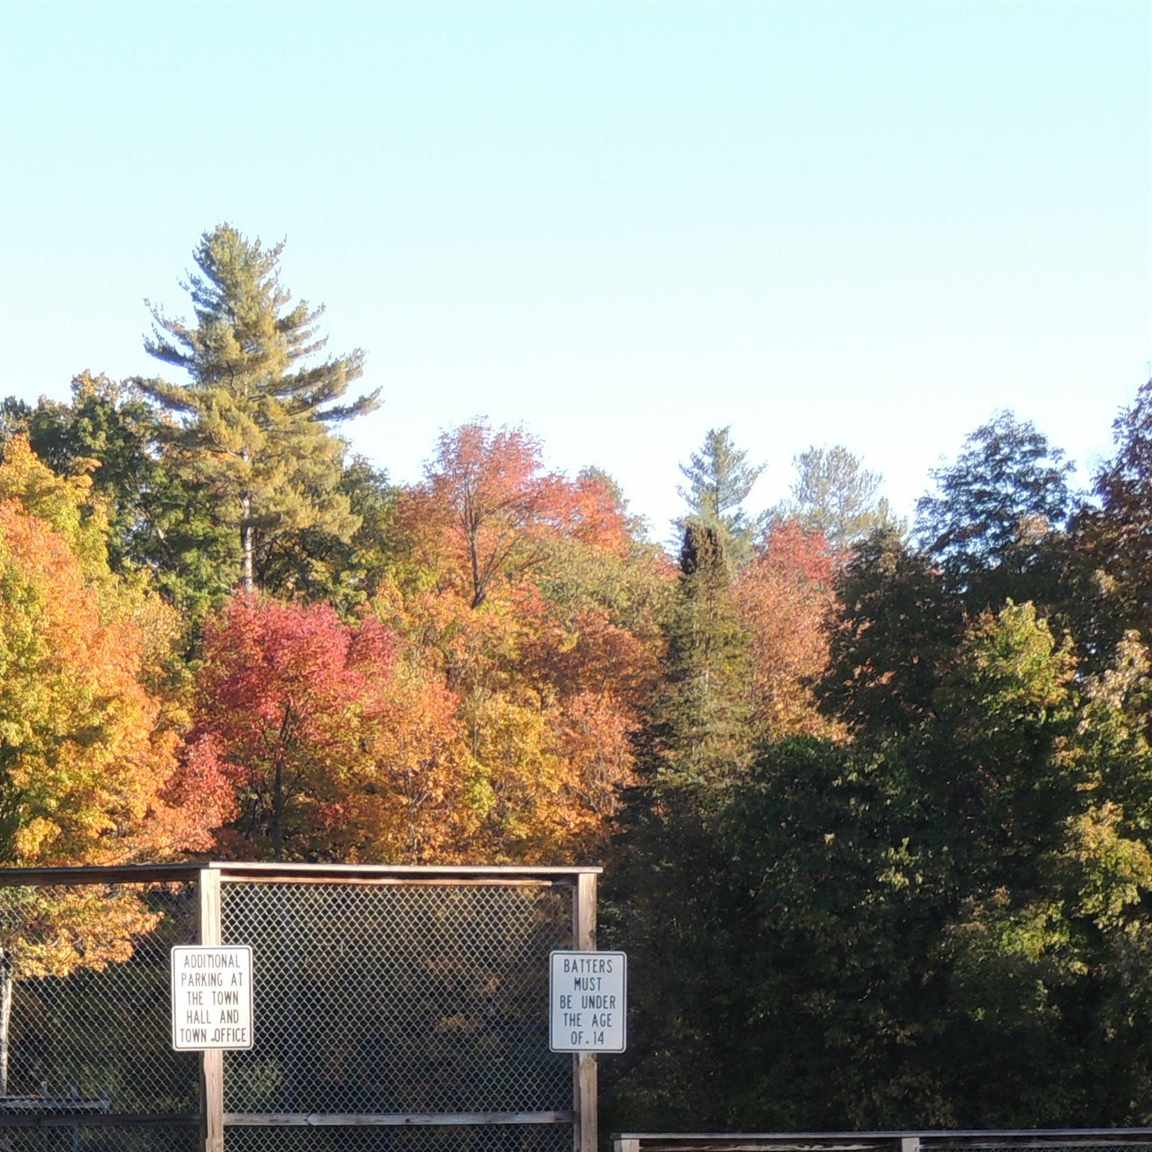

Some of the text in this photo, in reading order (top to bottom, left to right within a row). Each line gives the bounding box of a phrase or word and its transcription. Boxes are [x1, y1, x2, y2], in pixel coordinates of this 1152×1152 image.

[183, 954, 241, 969] ADDITIONAL
[564, 959, 613, 973] BATTERS
[181, 972, 243, 987] PARKING AT
[574, 977, 602, 991] MUST
[187, 991, 239, 1005] THE TOWN
[559, 995, 616, 1009] BE UNDER
[186, 1009, 239, 1024] HALL AND
[563, 1013, 613, 1027] THE AGE
[180, 1028, 246, 1043] TOWN OFFICE
[593, 1031, 604, 1045] 14
